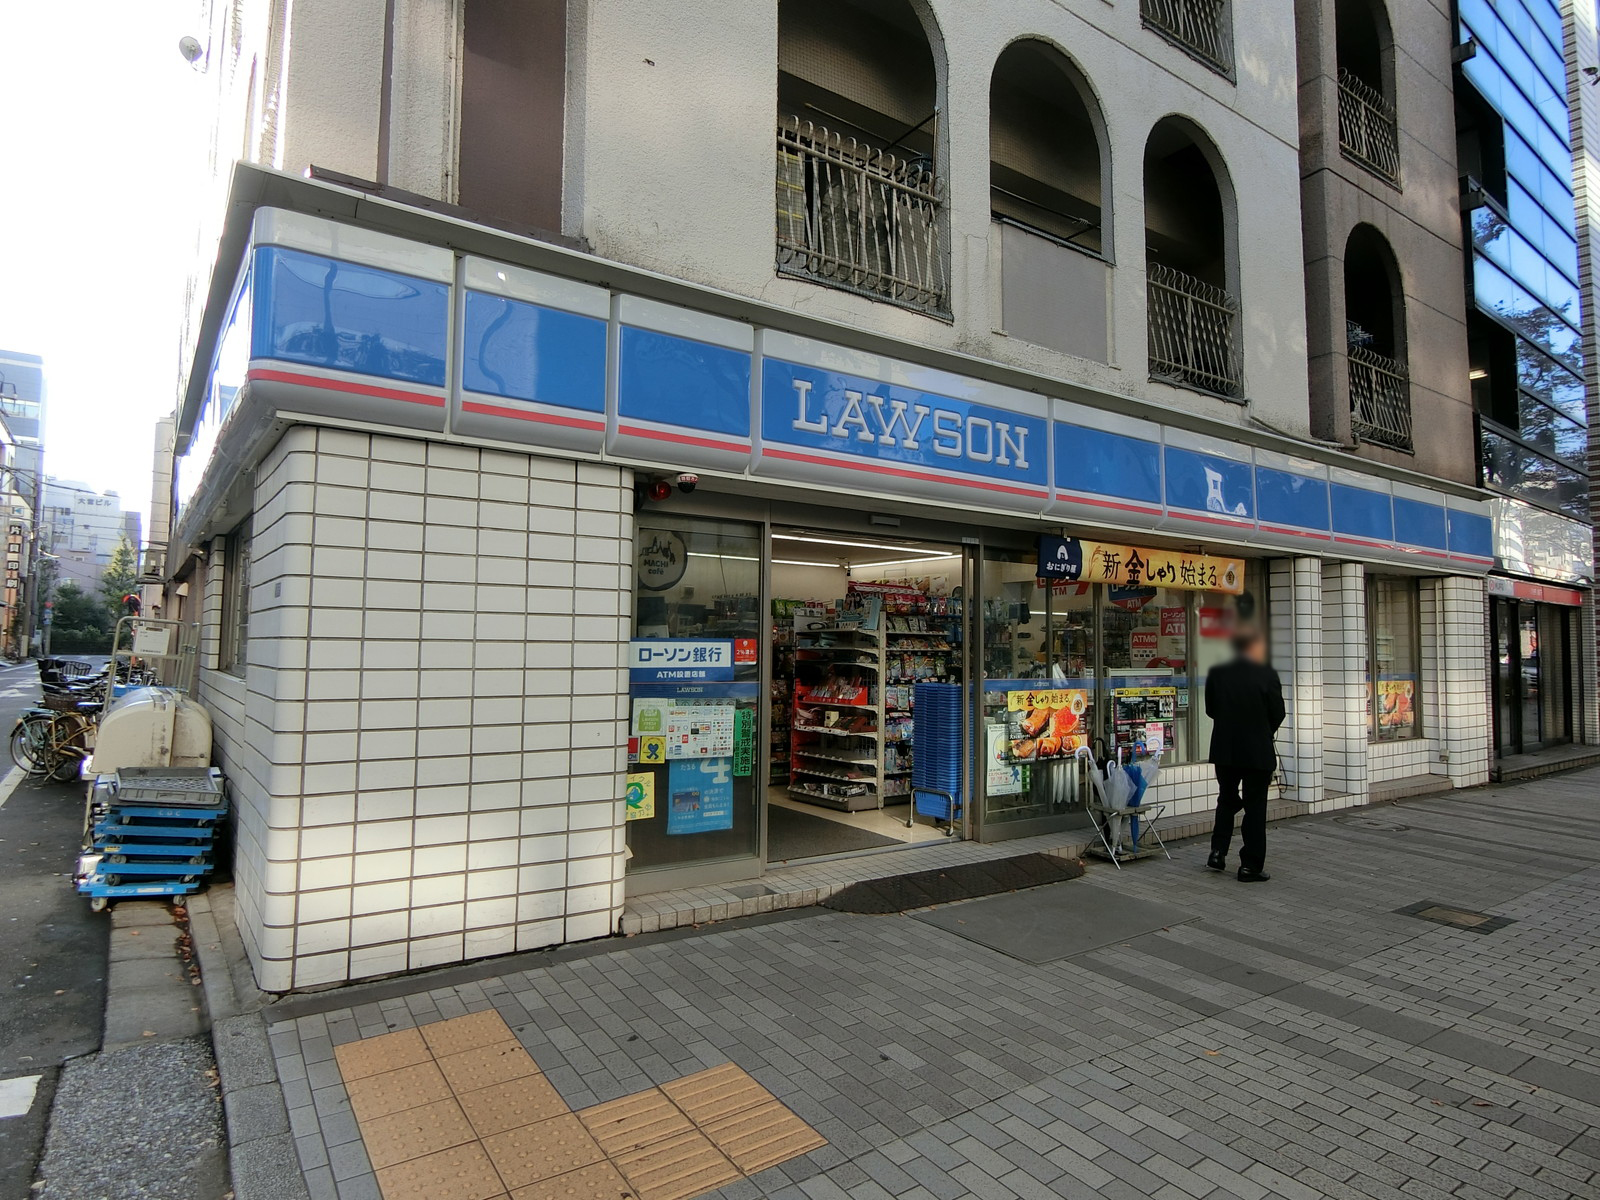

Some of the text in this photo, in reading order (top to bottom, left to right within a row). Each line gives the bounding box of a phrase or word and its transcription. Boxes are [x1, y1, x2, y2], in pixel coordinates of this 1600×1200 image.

[793, 378, 1029, 470] LAWSON
[643, 559, 669, 568] MACHI
[1046, 561, 1077, 574] おにぎり屋
[1127, 599, 1141, 609] ATM
[638, 647, 722, 662] ローソン銀行
[740, 710, 753, 774] 特別警戒実施中
